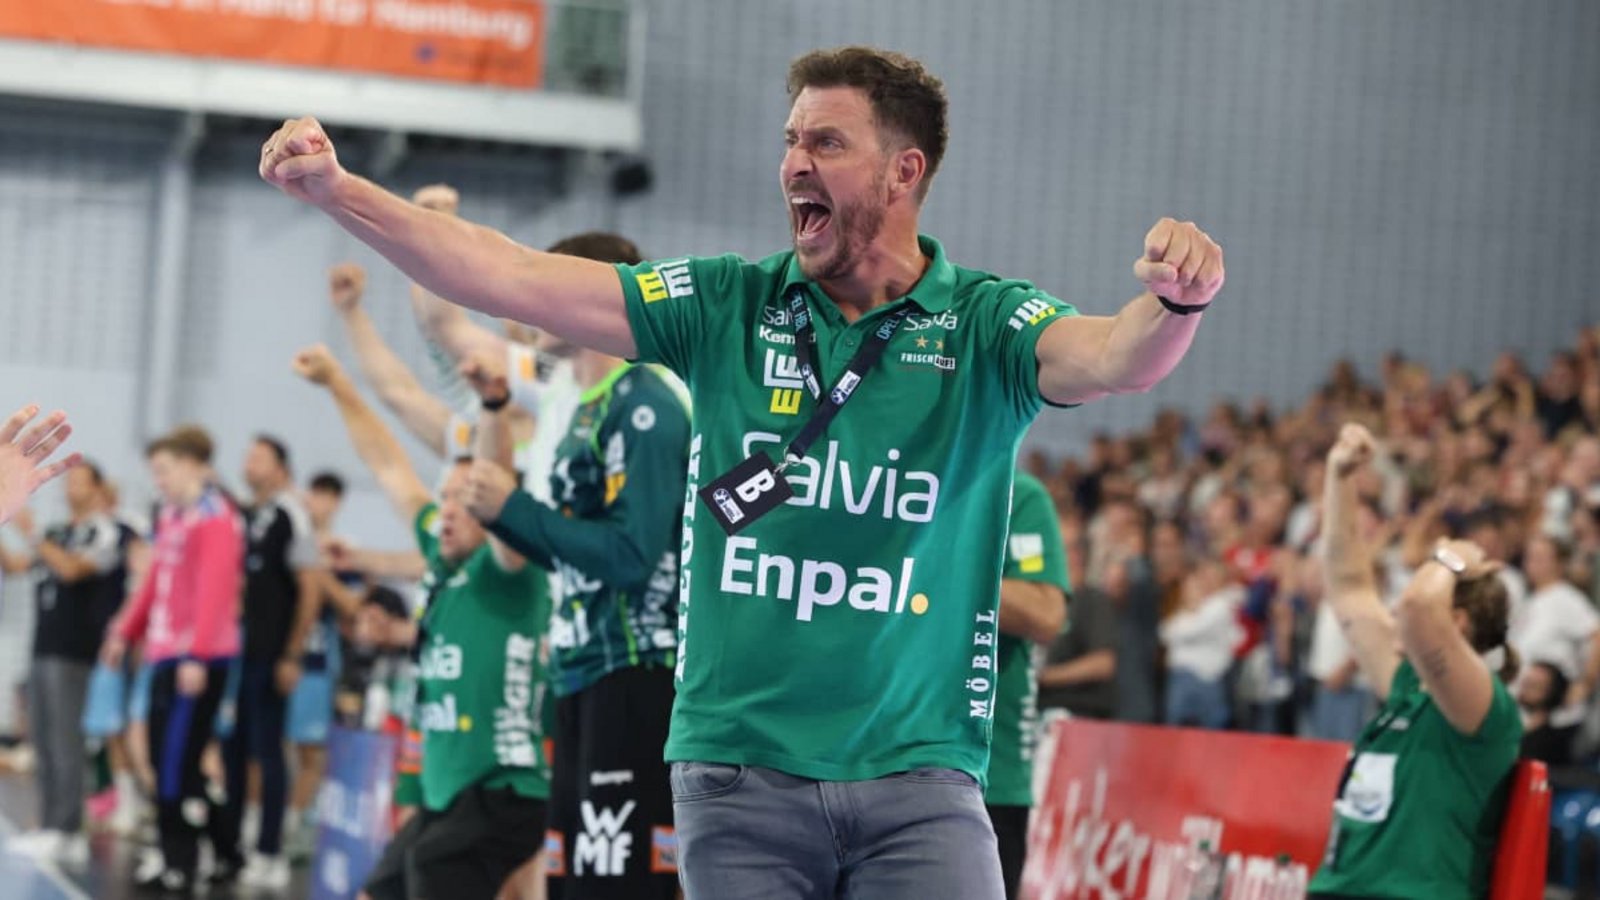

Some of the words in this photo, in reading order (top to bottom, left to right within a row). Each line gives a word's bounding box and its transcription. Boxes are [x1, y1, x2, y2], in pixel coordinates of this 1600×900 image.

[901, 351, 935, 364] FRISCH
[735, 468, 776, 503] B
[719, 534, 929, 622] Enpal.
[965, 608, 996, 719] MÖBEL
